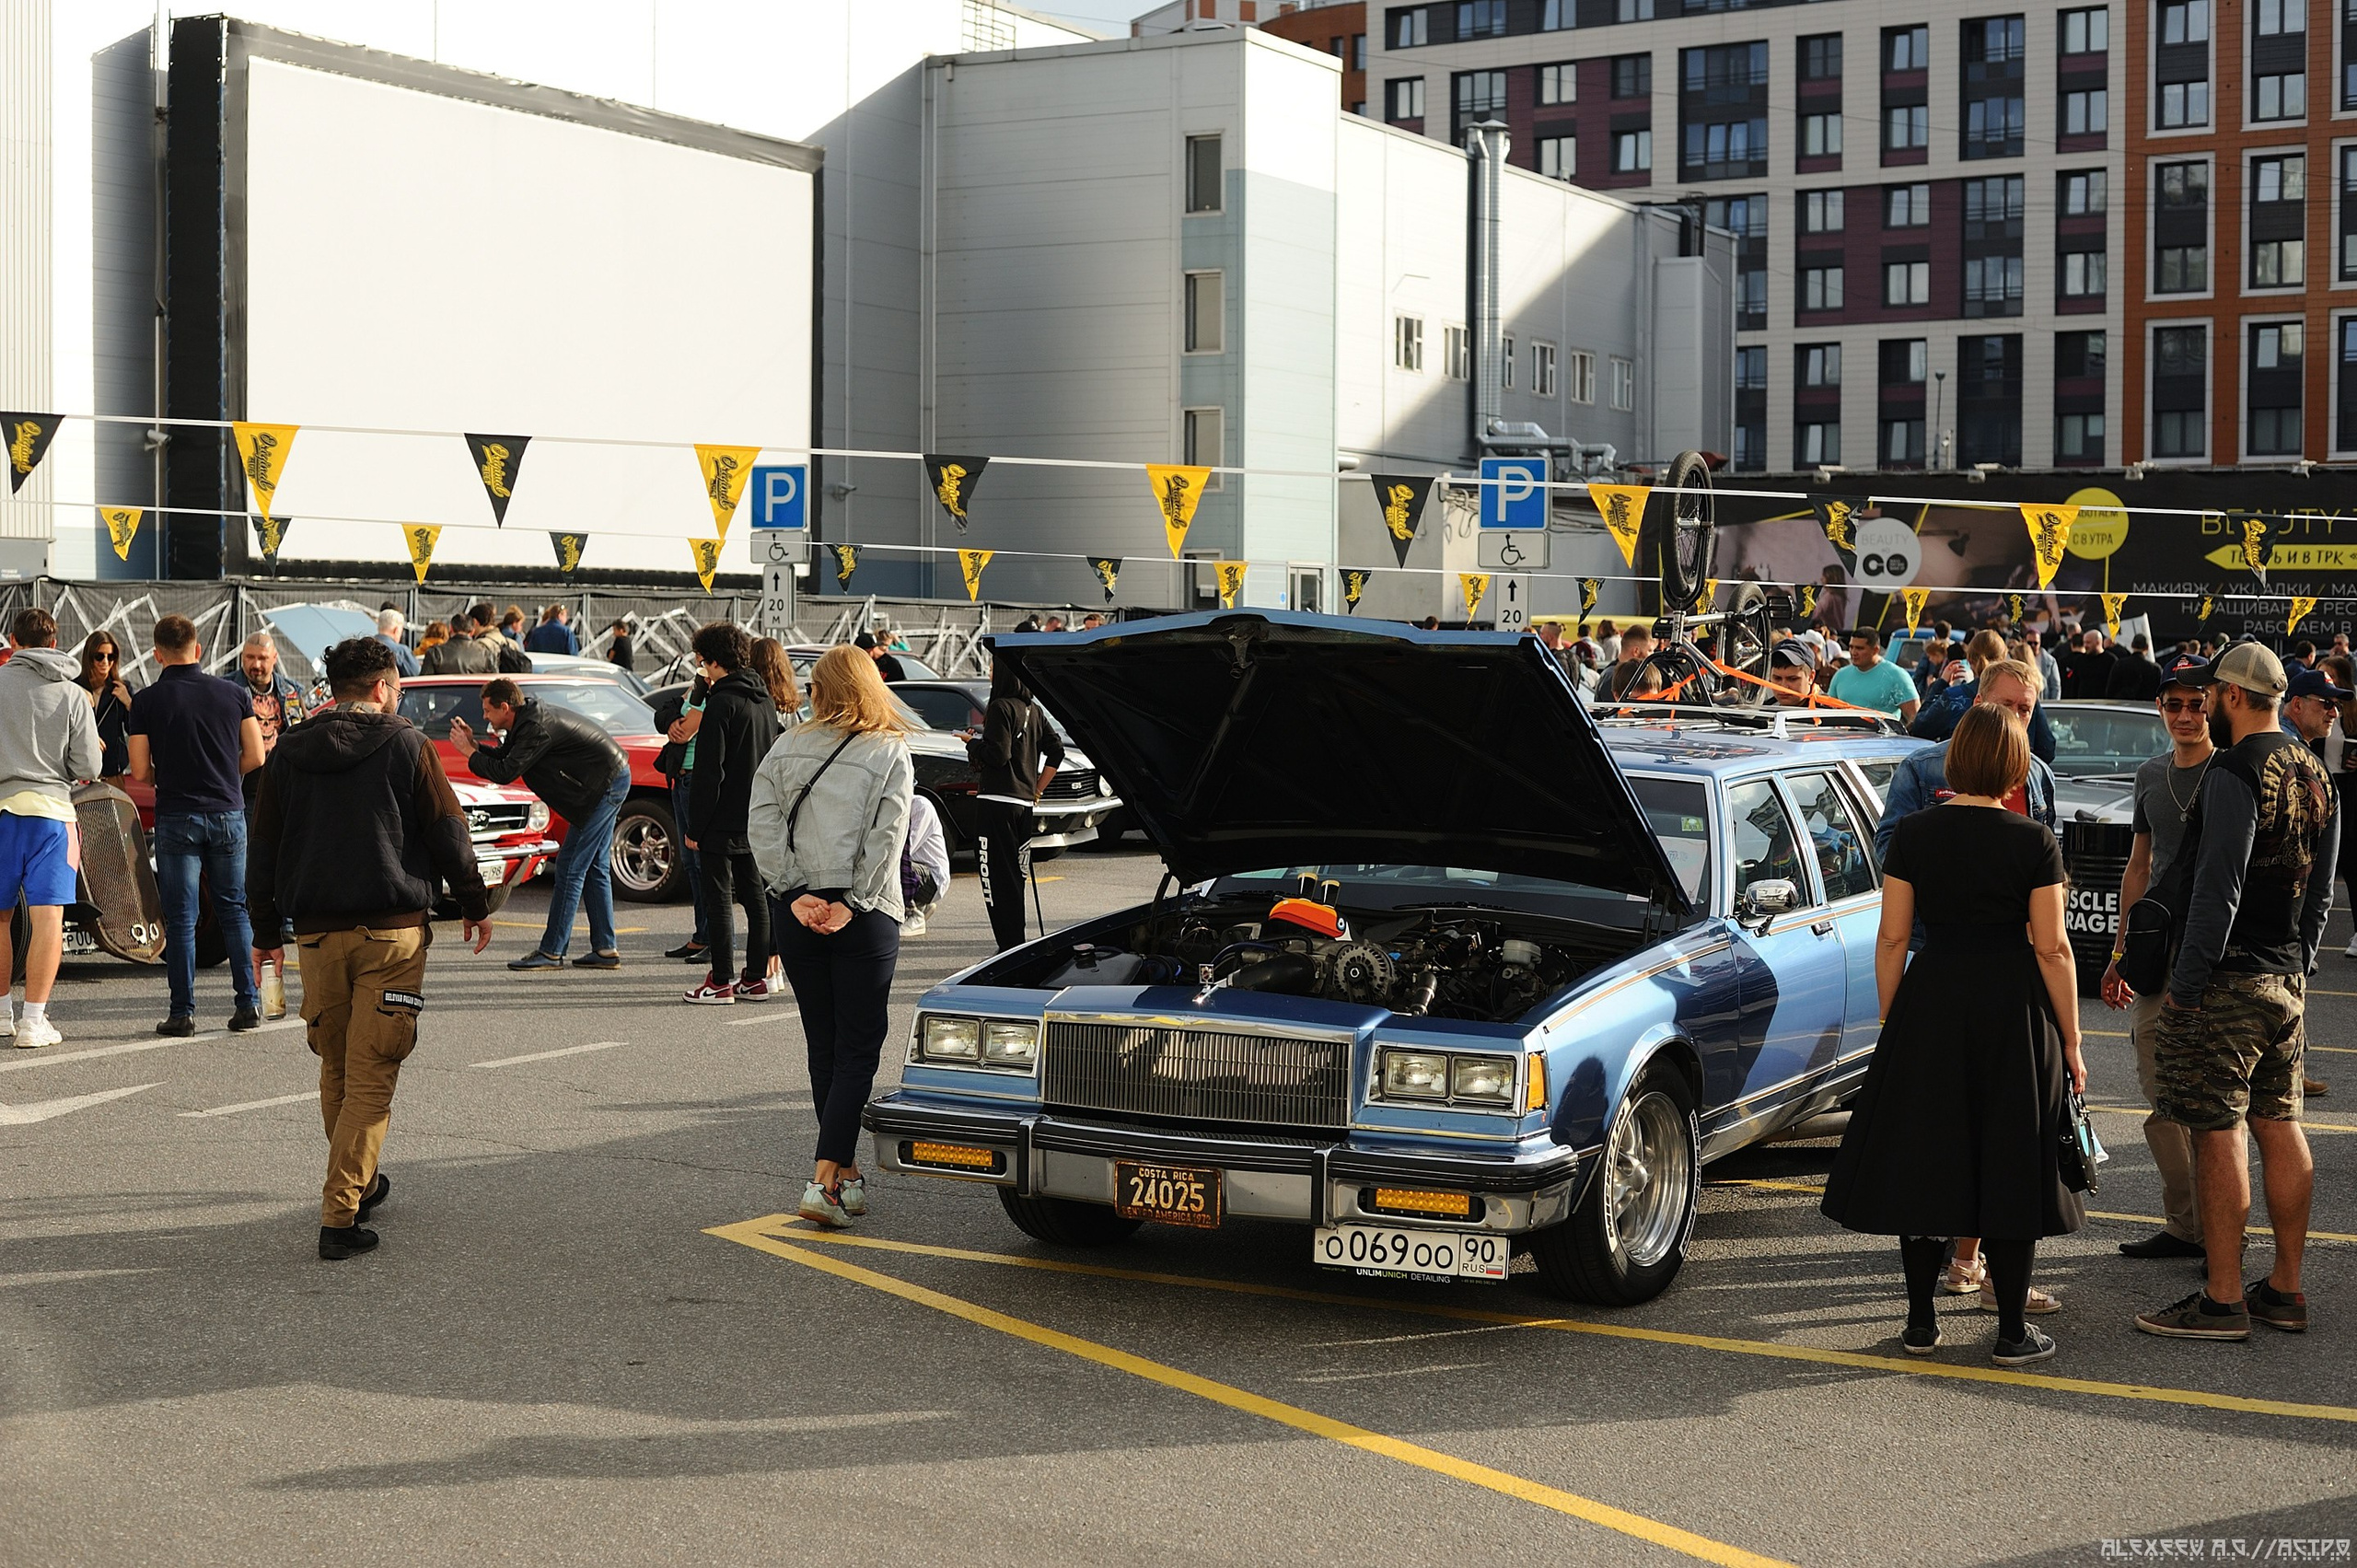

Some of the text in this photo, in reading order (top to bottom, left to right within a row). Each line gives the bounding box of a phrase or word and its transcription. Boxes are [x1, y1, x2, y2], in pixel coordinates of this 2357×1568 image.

[253, 432, 277, 490] Original
[485, 443, 510, 497] Original
[715, 455, 737, 510] Original
[1497, 466, 1535, 522] P
[764, 471, 796, 523] P
[1167, 474, 1189, 529] Original
[1390, 484, 1414, 540] Original
[1611, 493, 1637, 536] Original
[1861, 534, 1910, 546] BEAUTY
[2040, 511, 2061, 566] Original
[2089, 532, 2114, 545] УТРА
[2316, 550, 2344, 565] ТРК
[2132, 582, 2210, 594] МАКИЯЖ
[768, 598, 784, 611] 20
[1502, 610, 1522, 623] 20
[2243, 620, 2352, 634] РАБОАЕМ В
[978, 835, 994, 907] PROFIT
[2066, 889, 2118, 912] SCLE
[2066, 911, 2120, 934] RAGE
[1138, 1167, 1195, 1181] COSTA RICA
[1606, 1106, 1626, 1238] MICHELIN
[1130, 1177, 1205, 1213] 24025
[1155, 1209, 1191, 1223] AMERICA
[1464, 1237, 1495, 1263] 90
[1411, 1272, 1451, 1283] DETAILING
[1461, 1262, 1486, 1273] RUS
